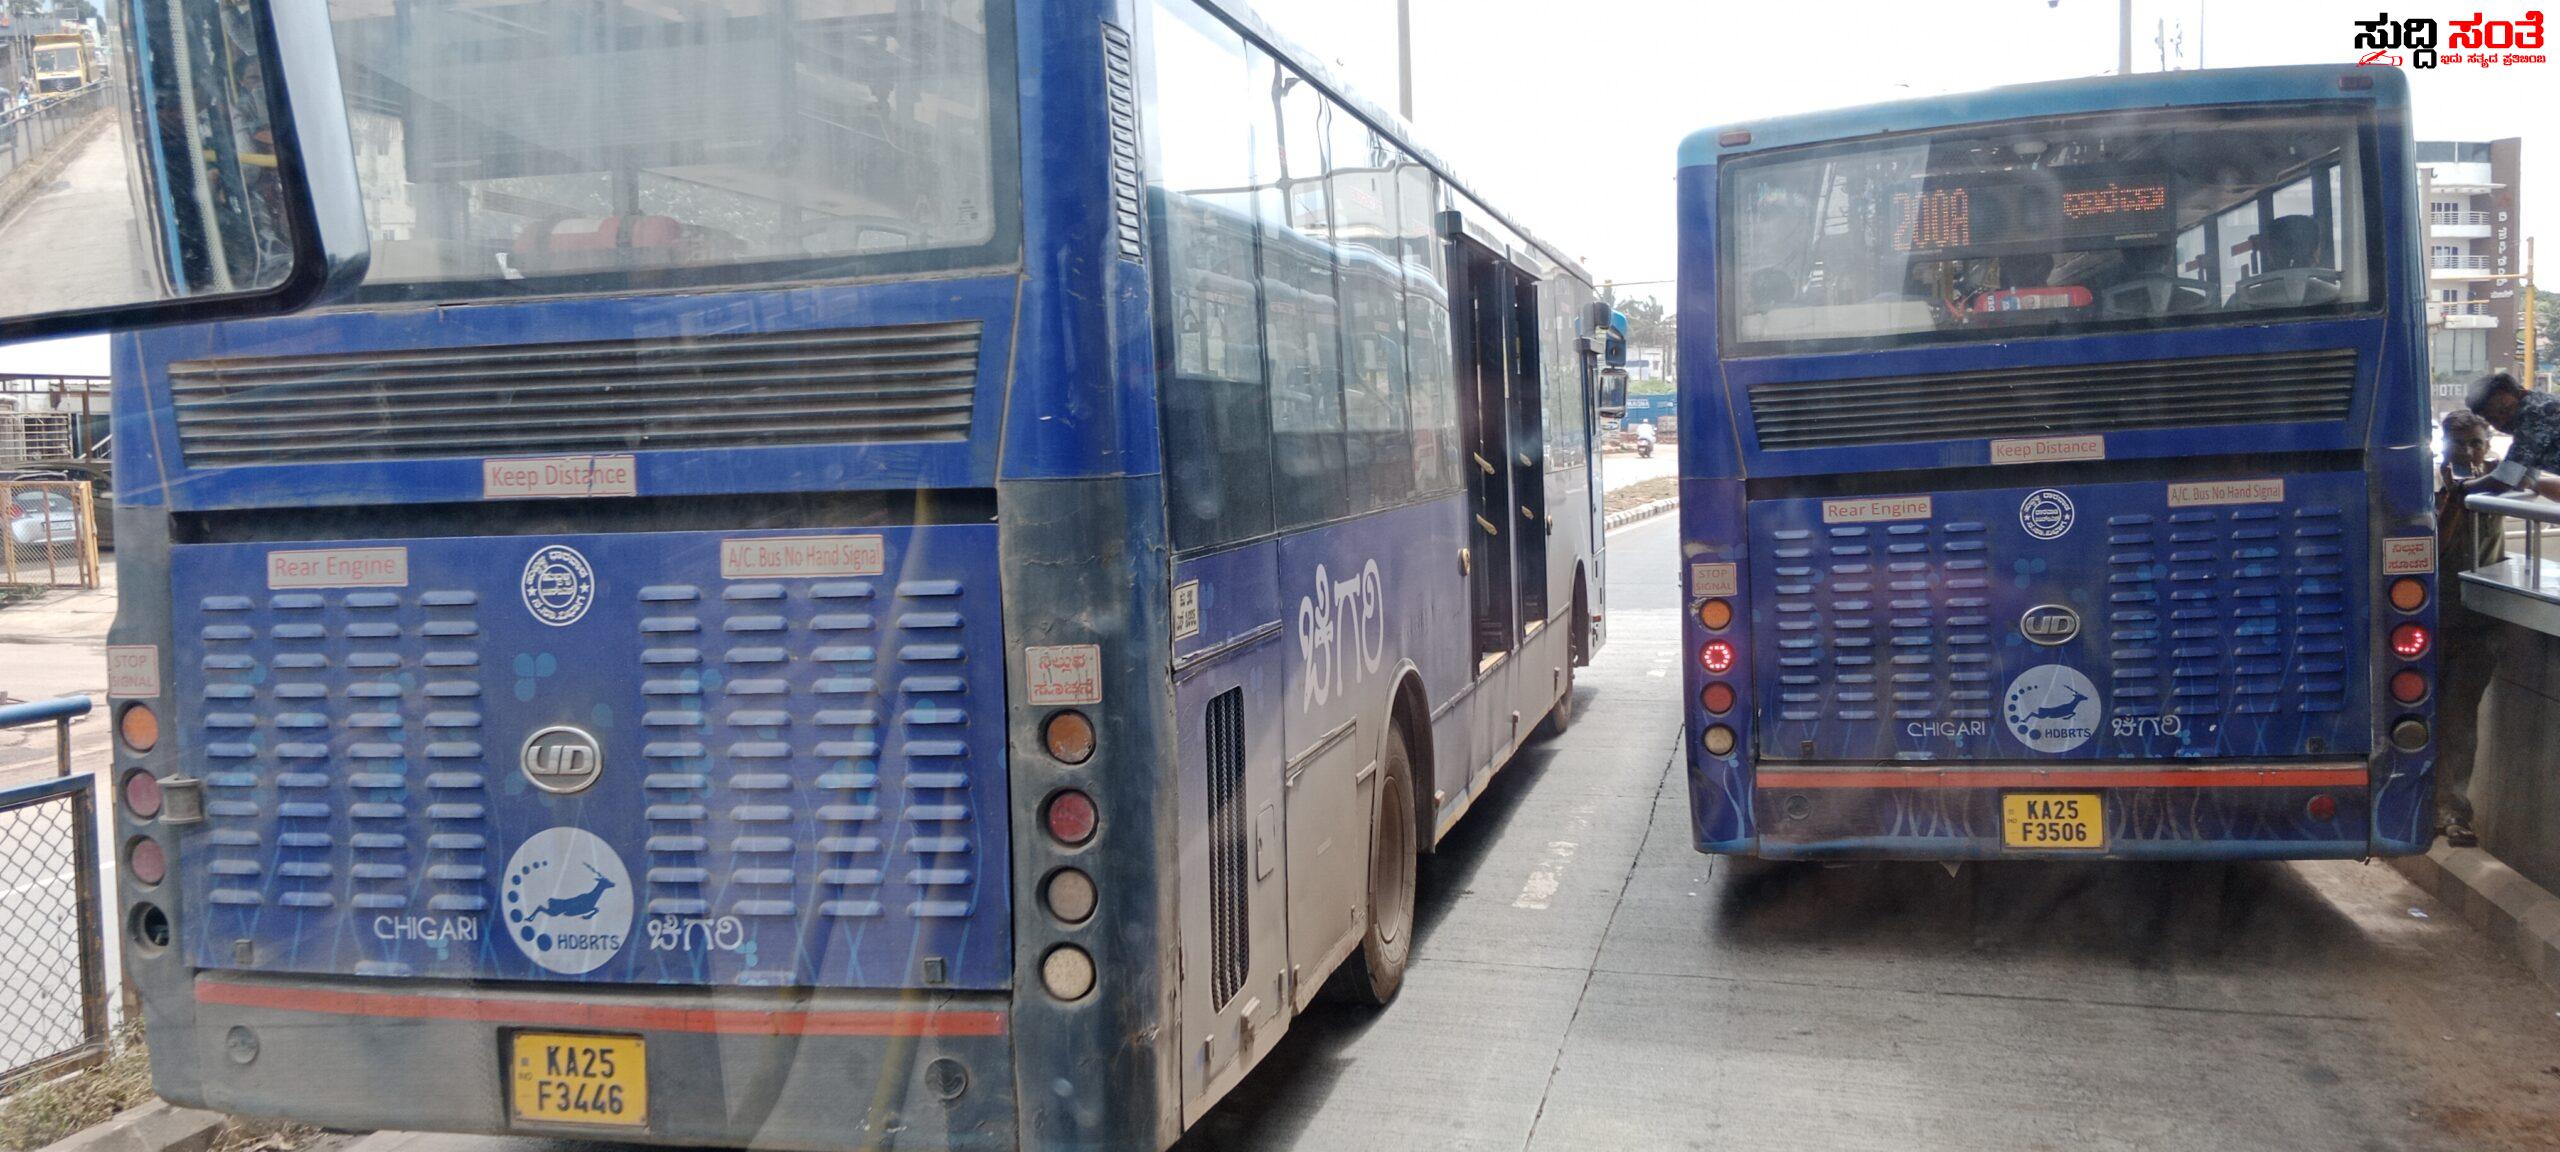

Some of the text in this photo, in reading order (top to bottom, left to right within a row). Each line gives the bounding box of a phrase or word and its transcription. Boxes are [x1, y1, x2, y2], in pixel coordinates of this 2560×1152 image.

[1996, 441, 2097, 458] Keep Distance
[492, 464, 627, 491] Keep Distance
[2193, 487, 2210, 500] Bus
[2212, 486, 2225, 499] No
[2227, 484, 2251, 499] Hand
[2253, 483, 2281, 501] Signal
[1828, 500, 1928, 518] Rear Engine
[759, 546, 782, 568] Bus
[784, 545, 803, 566] No
[806, 543, 840, 567] Hand
[843, 542, 881, 571] Signal
[275, 555, 396, 580] Rear Engine
[1698, 569, 1728, 579] STOP
[1694, 582, 1732, 592] SIGNAL
[2025, 615, 2076, 635] UD
[113, 655, 147, 668] STOP
[1907, 721, 1986, 737] CHIGARI
[2044, 727, 2092, 739] HDBRTS
[527, 745, 594, 775] UD
[2027, 800, 2079, 820] KA25
[2022, 822, 2087, 842] F3506
[373, 915, 478, 941] CHIGARI
[557, 933, 621, 950] HDBRTS
[547, 1046, 615, 1078] KA25
[538, 1080, 625, 1115] F3446
